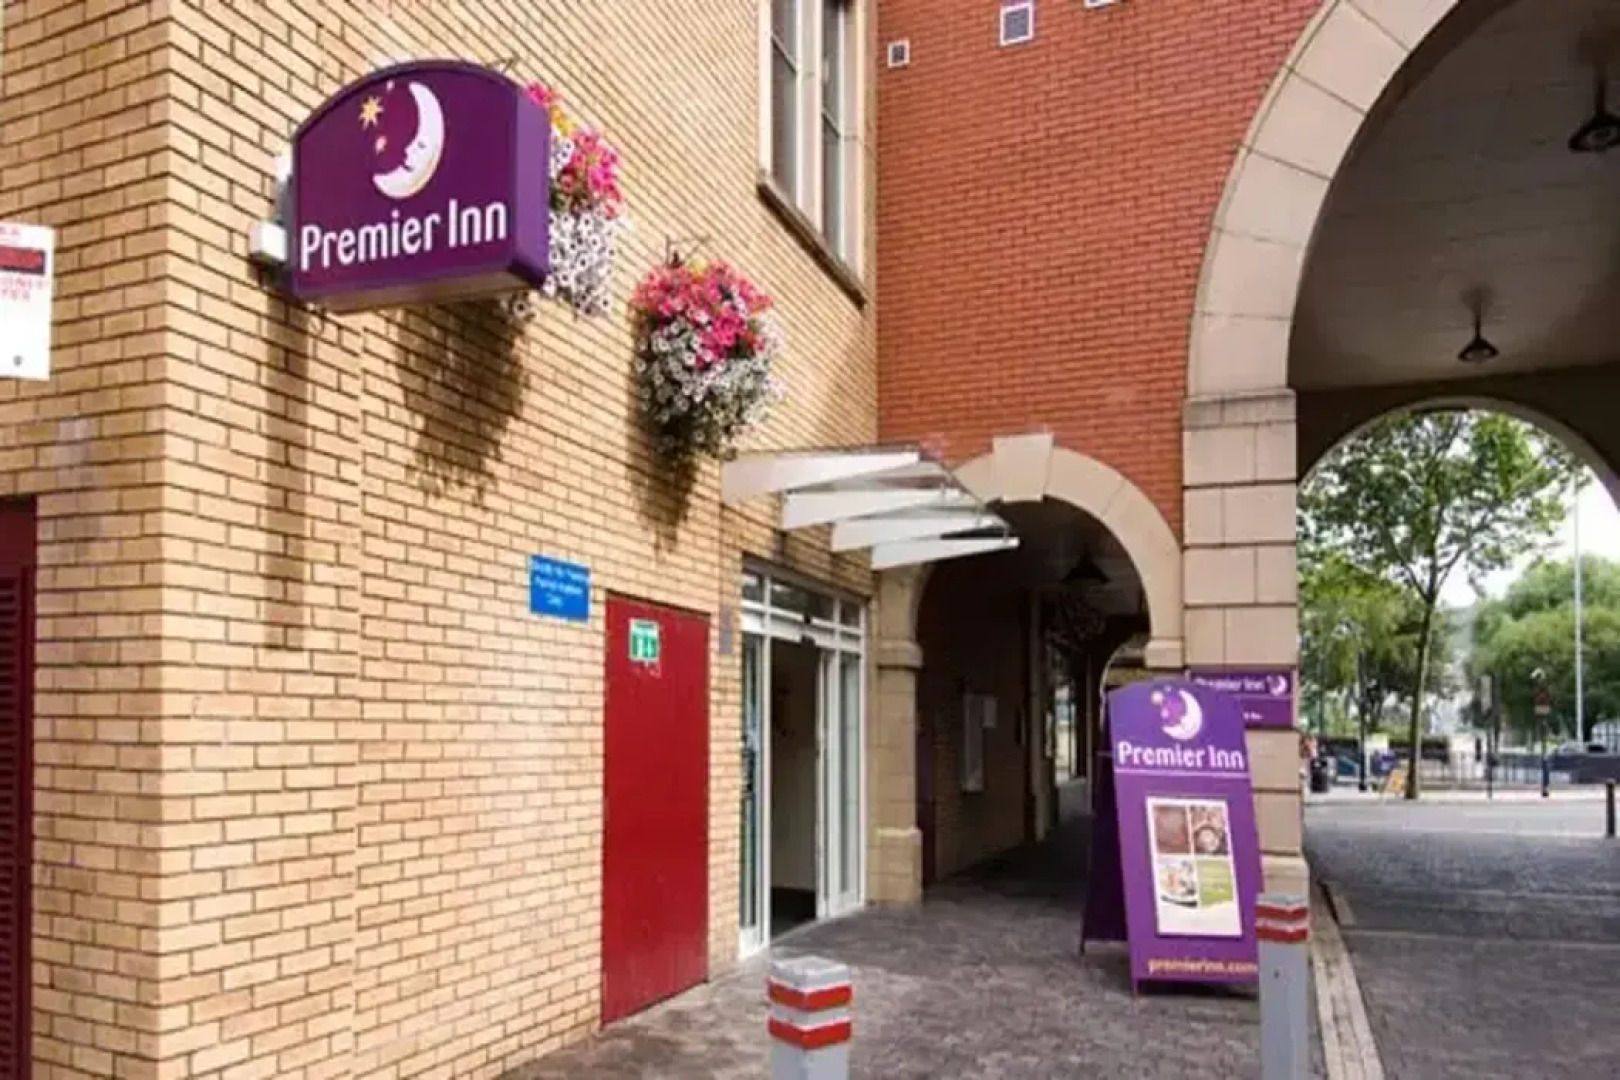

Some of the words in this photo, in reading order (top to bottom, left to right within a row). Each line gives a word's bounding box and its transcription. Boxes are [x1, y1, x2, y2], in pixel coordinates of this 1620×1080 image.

[300, 209, 441, 272] Premier
[448, 198, 508, 248] Inn
[1117, 740, 1206, 767] Premier
[1208, 744, 1246, 770] Inn
